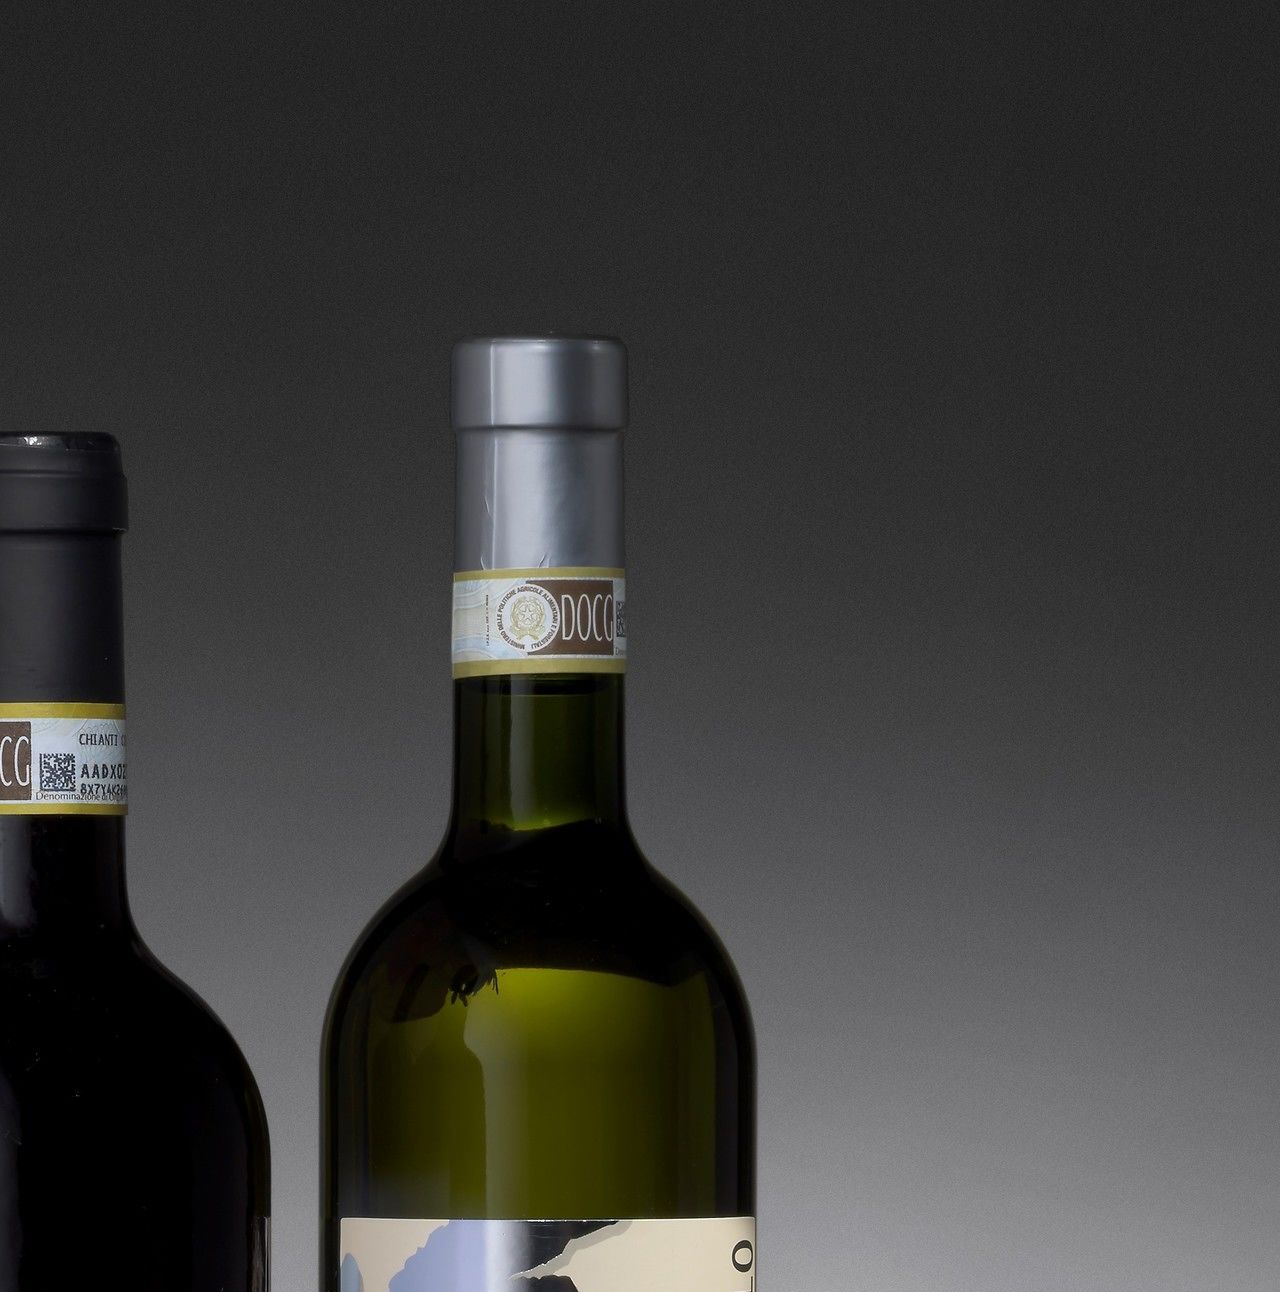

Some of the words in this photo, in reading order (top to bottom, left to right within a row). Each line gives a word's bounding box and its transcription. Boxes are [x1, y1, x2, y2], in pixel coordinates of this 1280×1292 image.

[498, 589, 516, 612] POLITICHE
[561, 593, 613, 642] DOCG
[79, 733, 118, 747] CHIANTI
